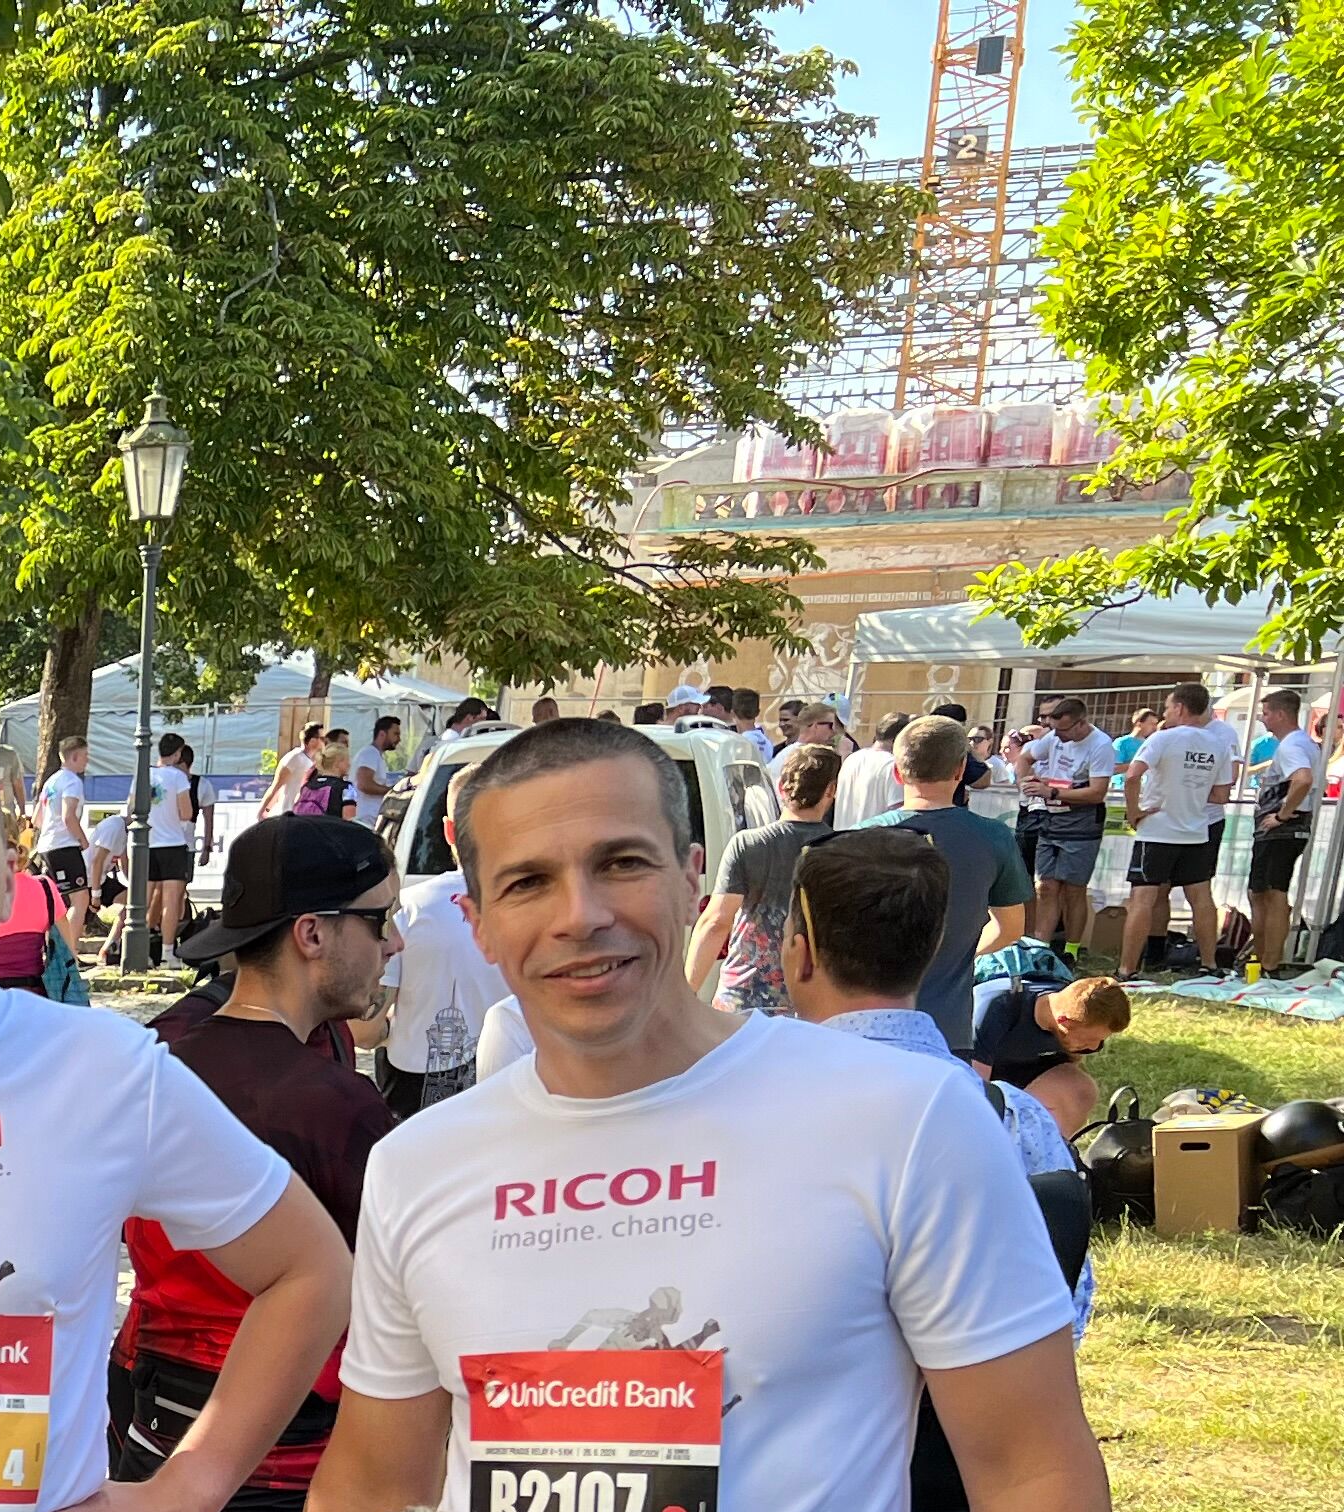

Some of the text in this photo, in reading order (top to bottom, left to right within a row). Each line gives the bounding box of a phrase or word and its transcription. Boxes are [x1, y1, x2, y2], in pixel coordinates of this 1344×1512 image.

[1185, 751, 1215, 764] IKEA
[494, 1160, 717, 1220] RICOH
[490, 1208, 722, 1251] imagine. change.
[624, 1381, 695, 1409] Bank
[3, 1449, 25, 1487] 4
